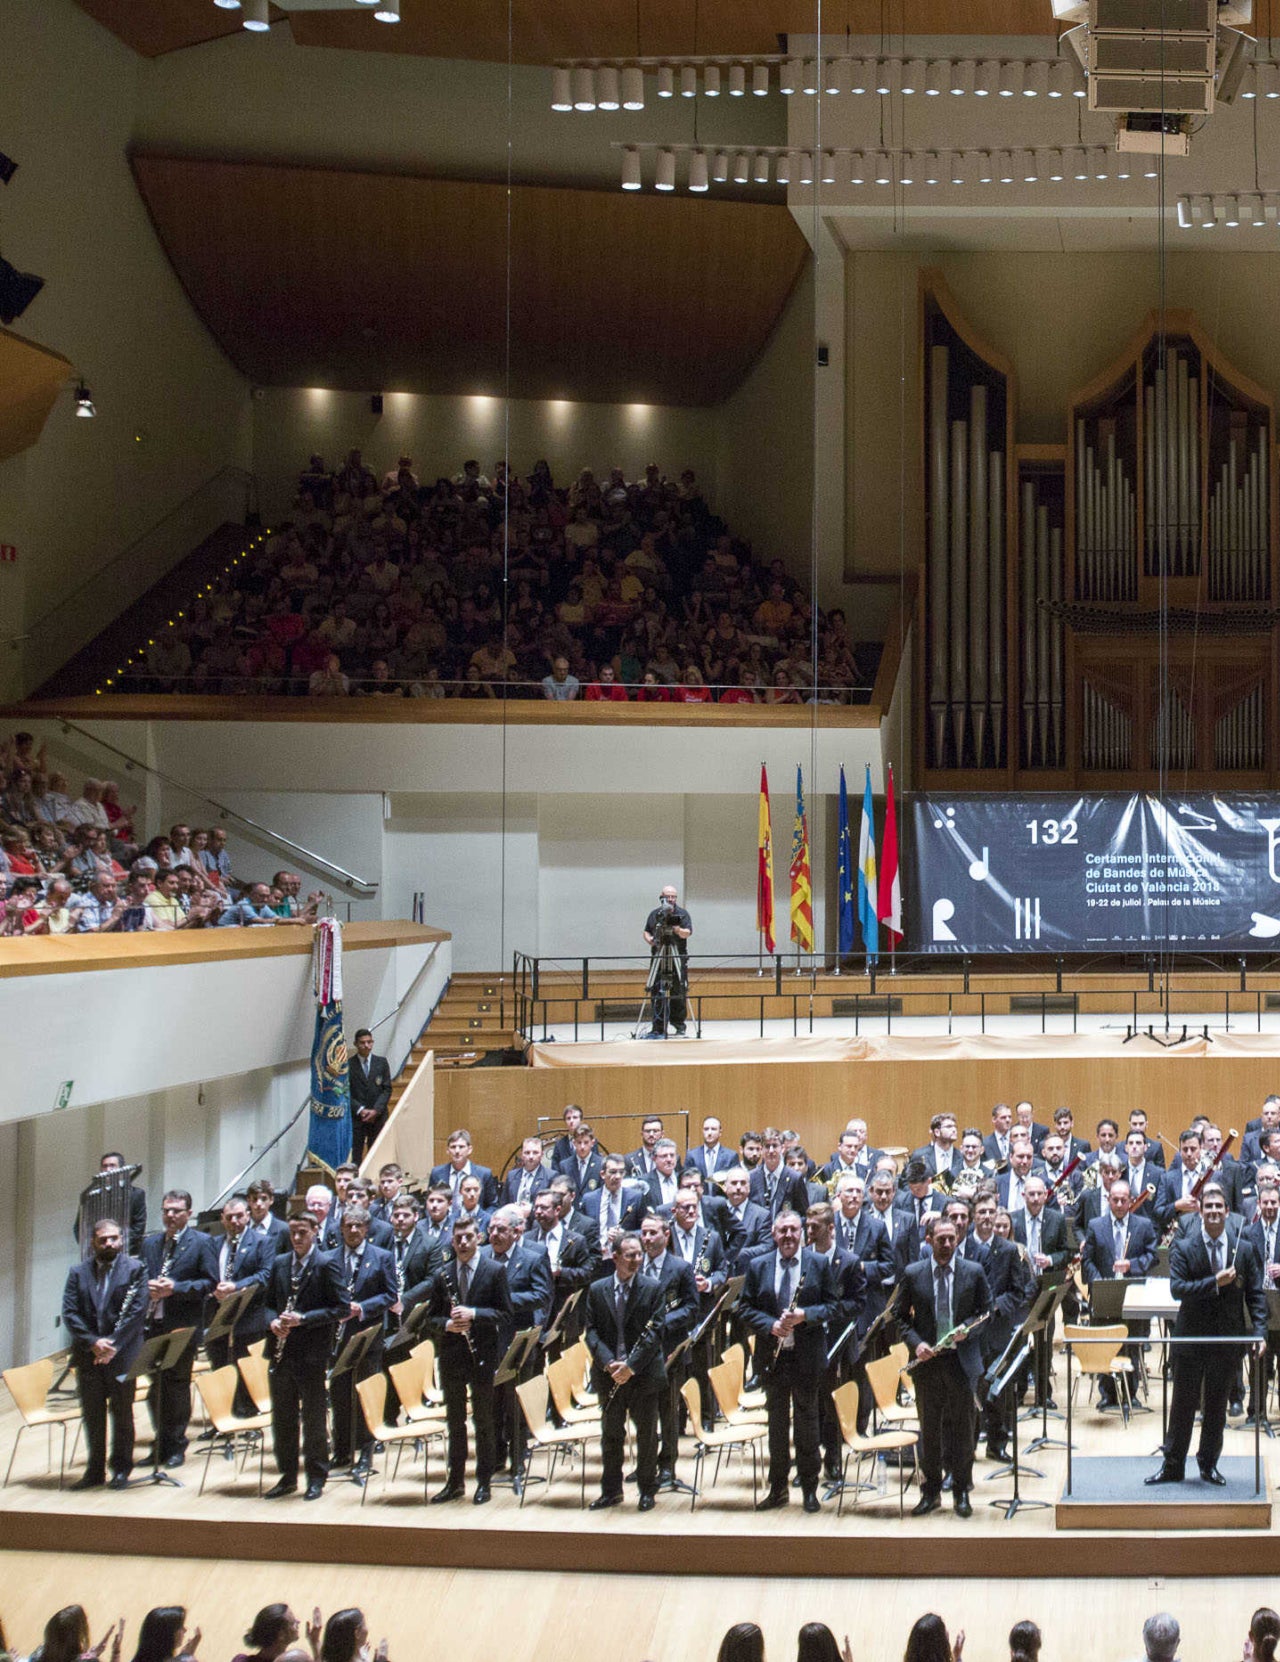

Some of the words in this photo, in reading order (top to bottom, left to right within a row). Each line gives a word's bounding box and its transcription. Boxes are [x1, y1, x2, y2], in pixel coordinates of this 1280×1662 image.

[1026, 819, 1078, 845] 132
[1086, 854, 1141, 864] Certamen
[1145, 852, 1220, 864] Interncionl
[1086, 868, 1100, 878] de
[1103, 868, 1146, 878] Bandes
[1150, 868, 1164, 878] de
[1085, 882, 1121, 893] Ciutat
[1123, 882, 1138, 892] de
[1141, 882, 1189, 892] València
[1192, 882, 1220, 892] 2018
[1110, 898, 1120, 907] de
[1147, 898, 1169, 906] Palau
[1171, 898, 1182, 906] de
[1183, 898, 1191, 906] la
